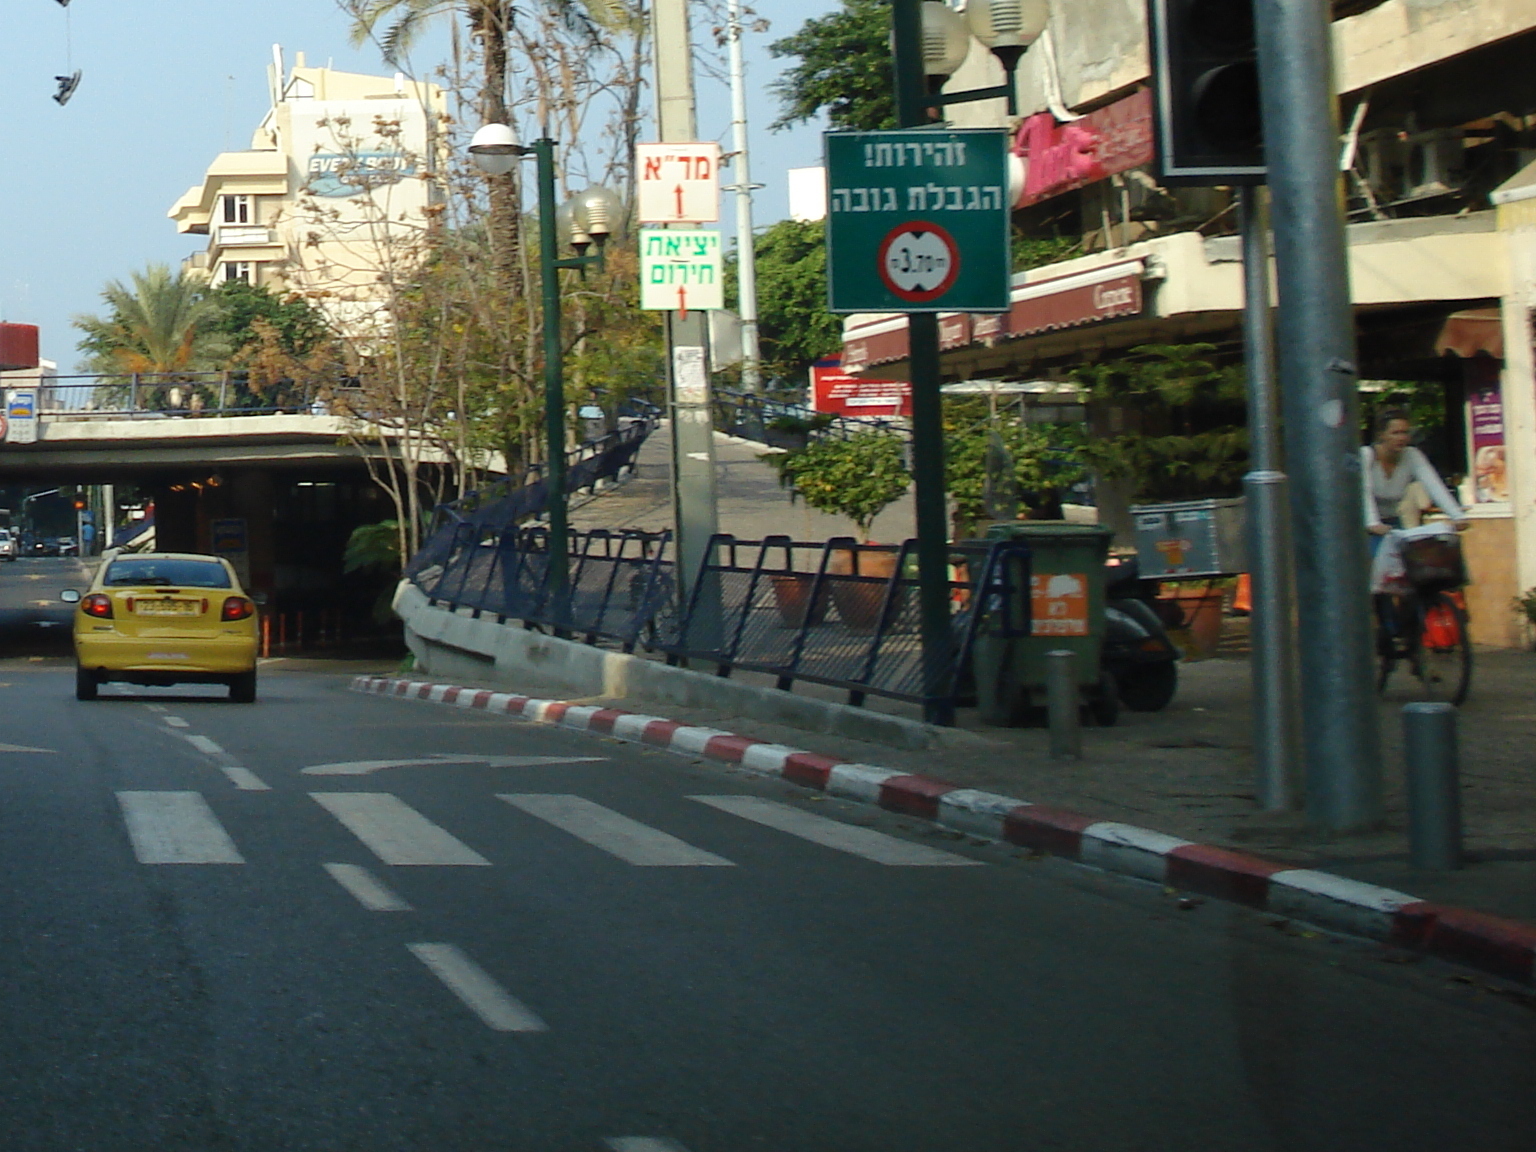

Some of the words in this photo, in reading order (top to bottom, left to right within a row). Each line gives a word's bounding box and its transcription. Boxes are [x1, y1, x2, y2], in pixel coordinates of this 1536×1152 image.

[864, 142, 966, 167] זהירות!
[832, 187, 898, 212] גובה
[907, 182, 1002, 211] הגבלת
[646, 236, 717, 256] יציאת
[650, 264, 713, 284] חירום
